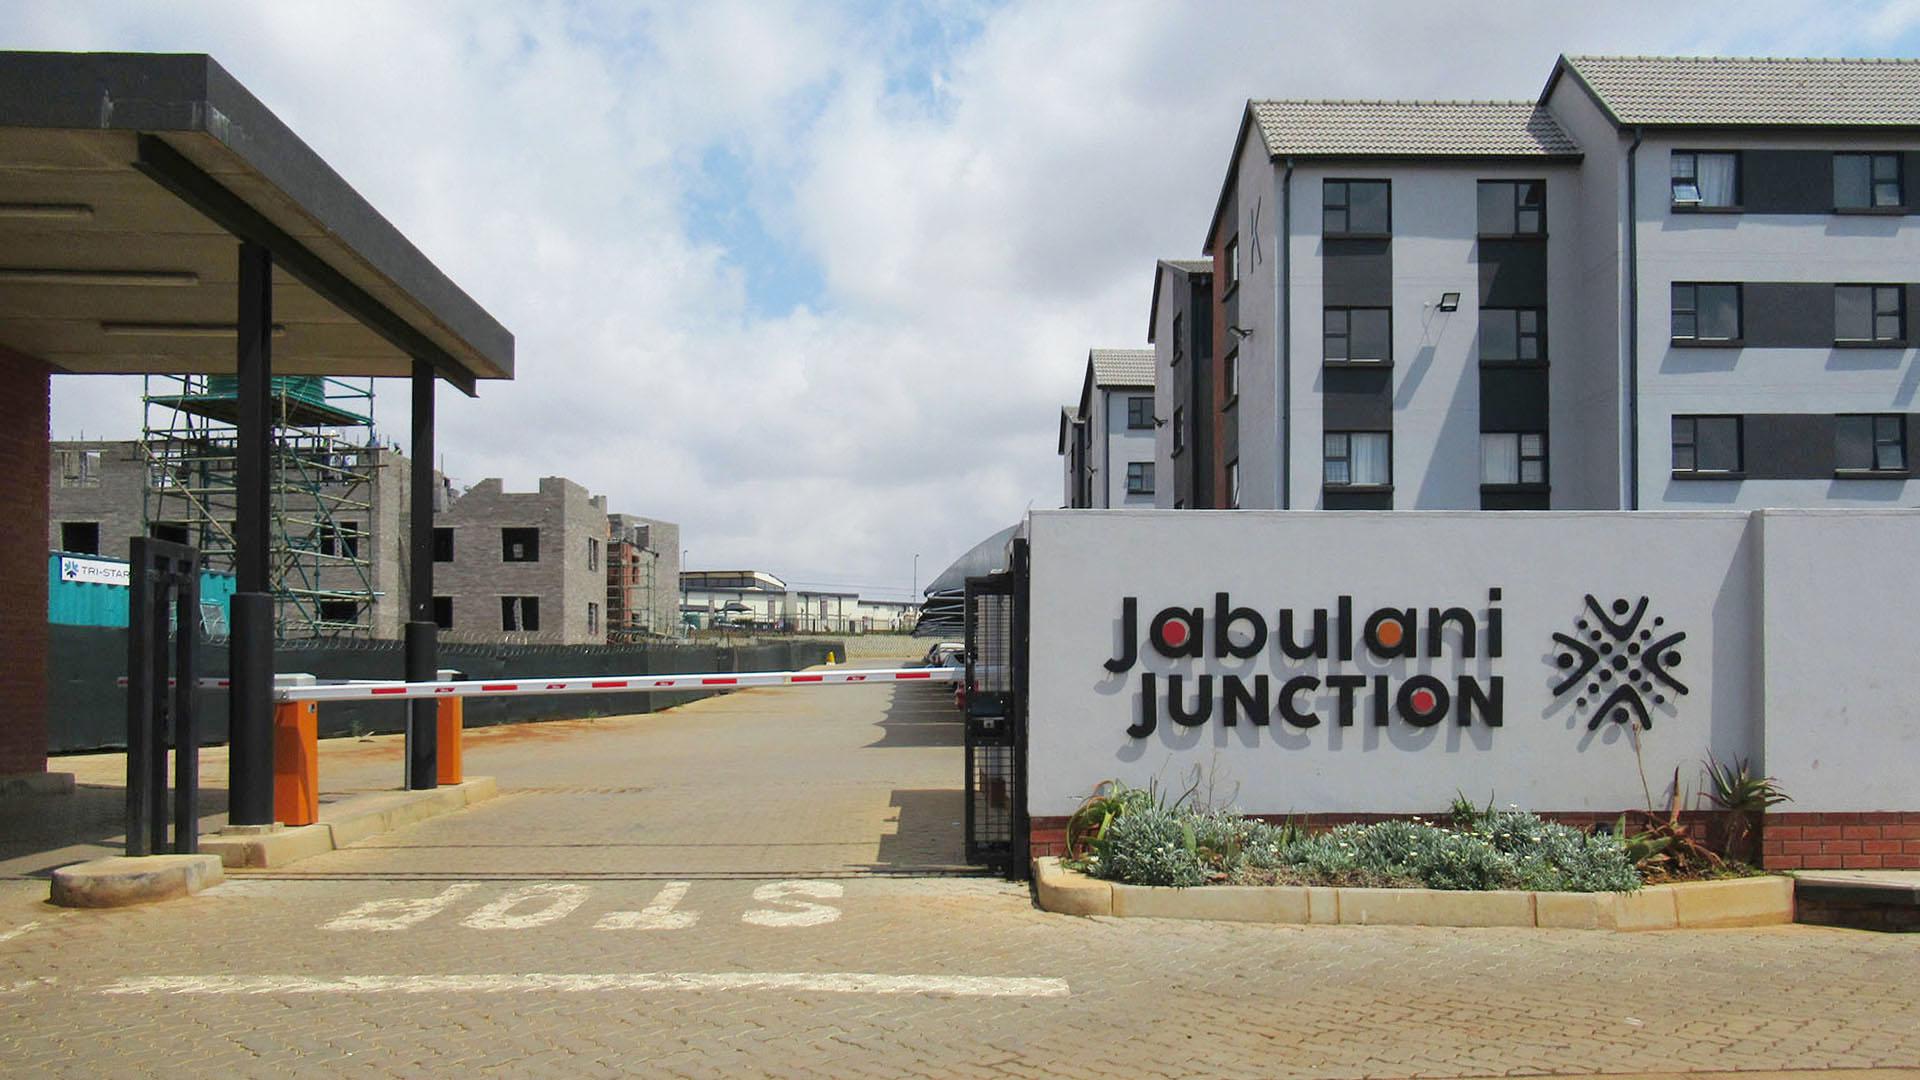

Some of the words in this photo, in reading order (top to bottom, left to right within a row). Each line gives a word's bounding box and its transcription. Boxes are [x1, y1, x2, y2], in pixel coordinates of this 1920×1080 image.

[1104, 587, 1503, 673] Jabulani
[1127, 673, 1503, 738] JUNCTION
[318, 881, 844, 931] STOP
